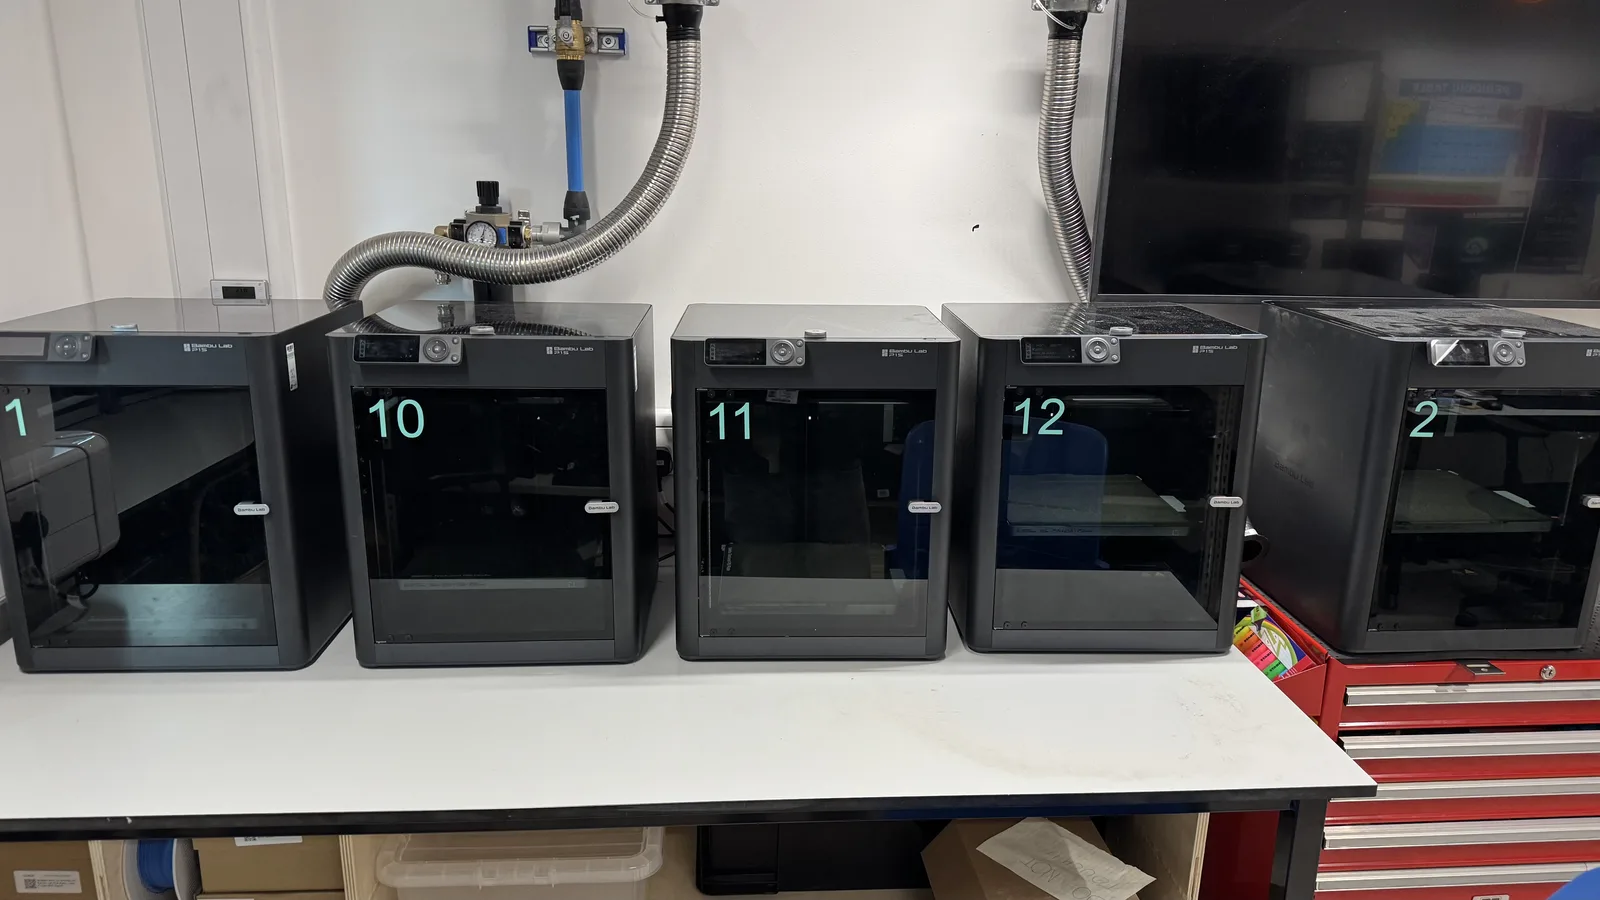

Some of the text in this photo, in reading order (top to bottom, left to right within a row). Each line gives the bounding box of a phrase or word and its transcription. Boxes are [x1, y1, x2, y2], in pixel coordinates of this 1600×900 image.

[5, 398, 27, 437] 1
[369, 398, 425, 439] 10
[710, 402, 751, 440] 11
[1015, 398, 1064, 436] 12
[1410, 400, 1438, 437] 2
[1018, 857, 1061, 883] NOT
